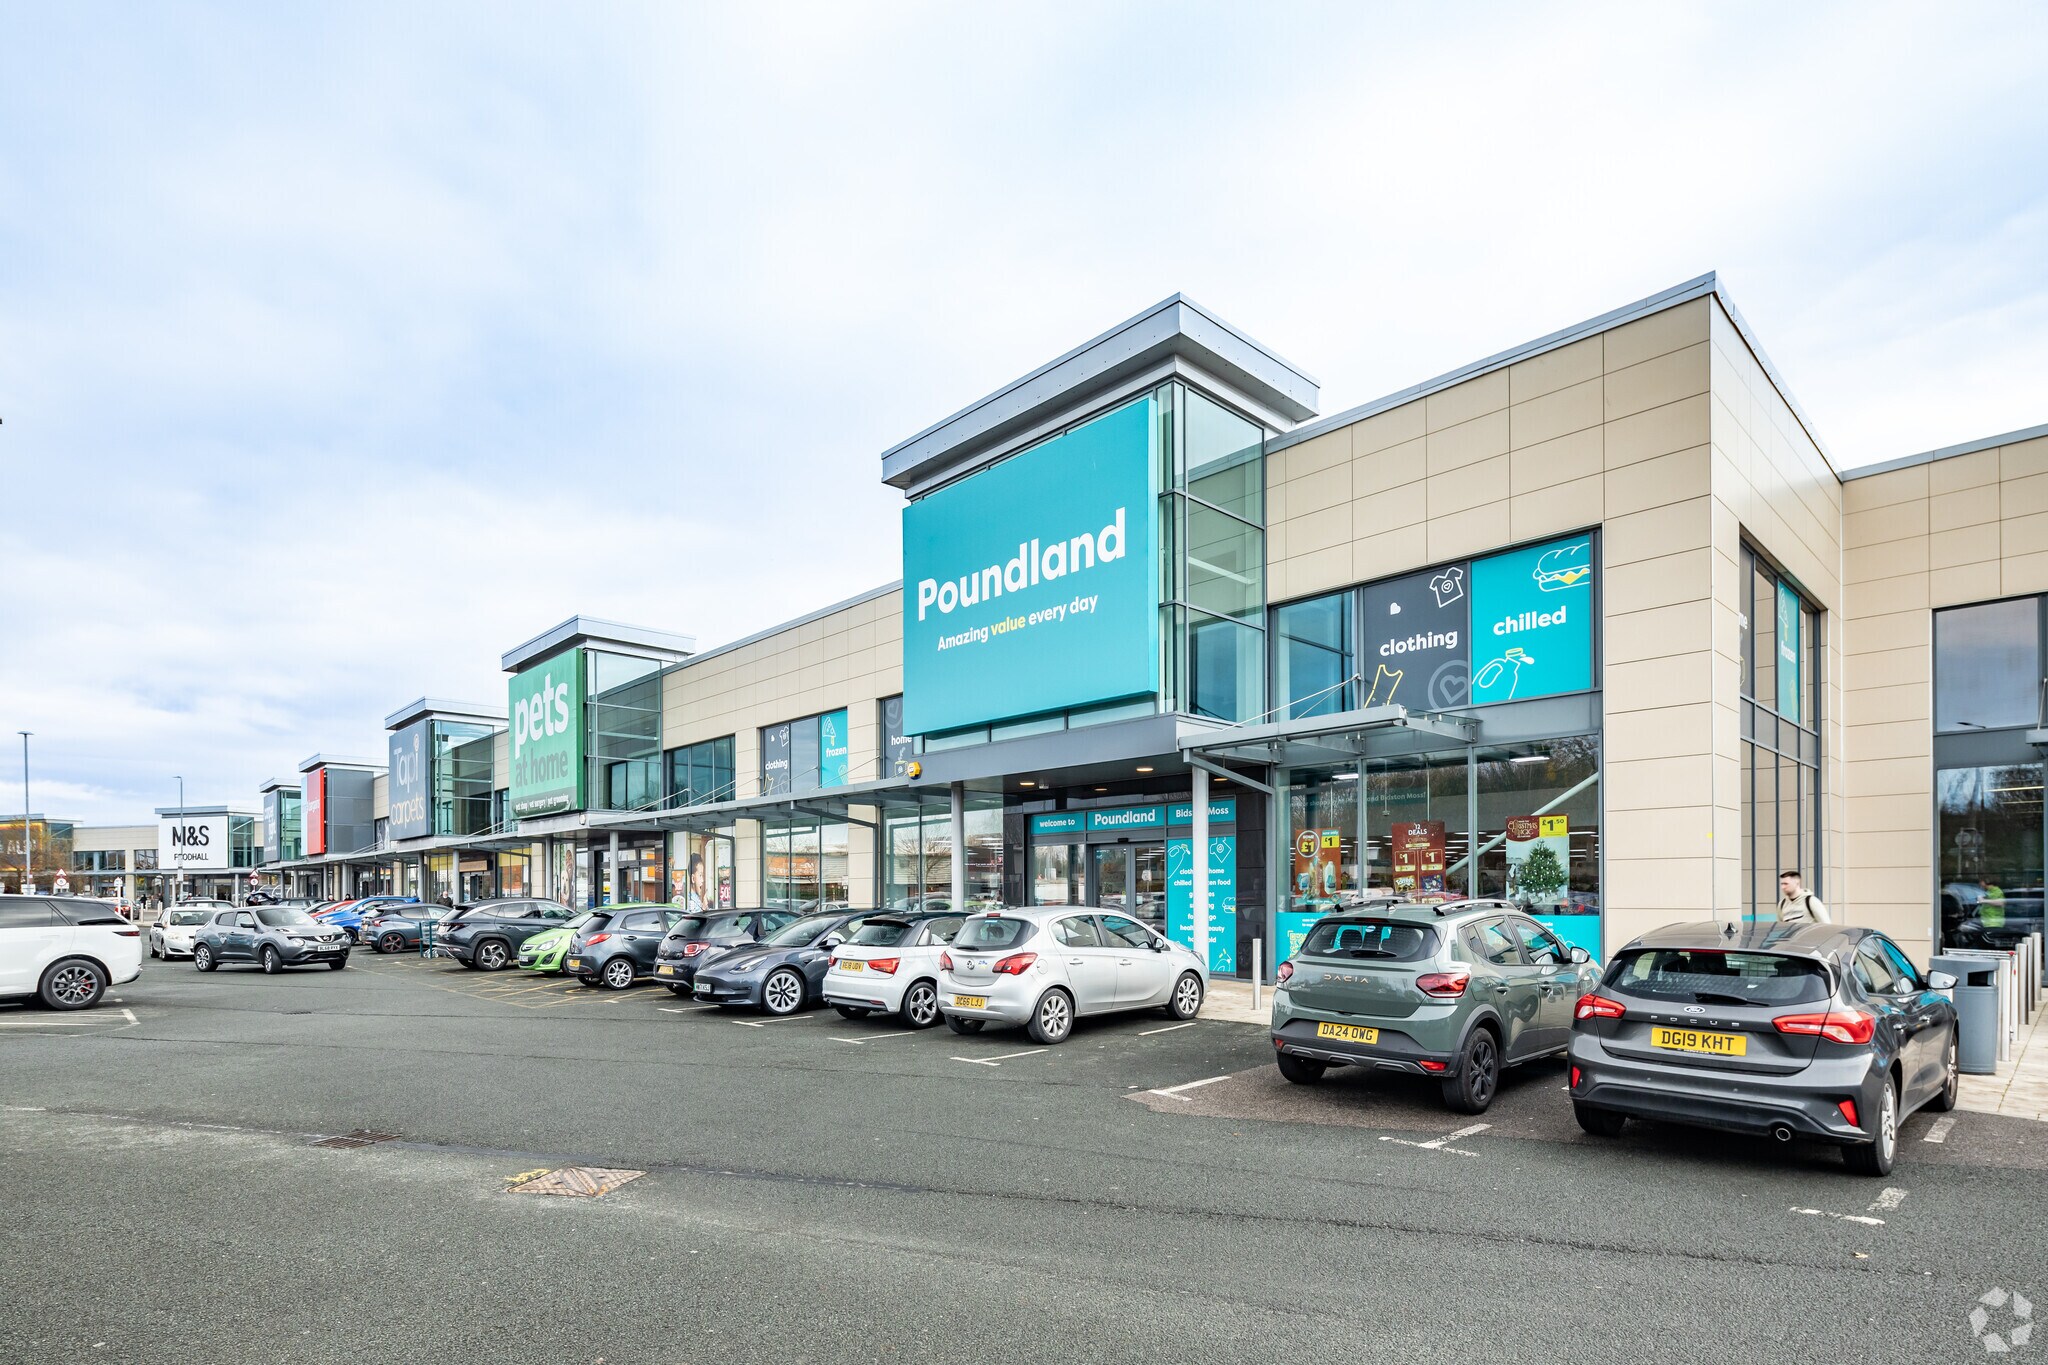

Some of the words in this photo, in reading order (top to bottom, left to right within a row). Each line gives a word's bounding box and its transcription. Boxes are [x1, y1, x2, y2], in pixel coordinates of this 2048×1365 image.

[917, 506, 1126, 622] Poundland
[937, 625, 989, 651] Amazing
[990, 613, 1026, 636] value
[1028, 603, 1067, 626] every
[1069, 593, 1099, 615] day
[1493, 605, 1567, 636] chilled
[1379, 630, 1458, 657] clothing
[1780, 640, 1796, 665] frozen
[514, 672, 569, 760] pets
[891, 735, 913, 746] home
[826, 746, 847, 758] frozen
[393, 733, 420, 793] Tapi
[515, 753, 528, 788] at
[530, 748, 569, 785] home
[765, 758, 788, 771] clothing
[391, 793, 425, 829] carpets
[1094, 809, 1155, 826] Poundland
[1208, 806, 1229, 816] Moss
[1039, 819, 1067, 828] welcome
[1067, 818, 1075, 826] to
[172, 825, 210, 846] M&S
[1408, 828, 1428, 836] DEALS
[1300, 841, 1315, 853] £1
[1324, 837, 1333, 847] £1
[173, 853, 209, 861] FODHALL
[1217, 878, 1231, 886] food
[1323, 973, 1369, 984] DACIA
[1650, 1015, 1740, 1027] FOCUS
[1322, 1024, 1349, 1038] DA24
[1351, 1027, 1373, 1041] OWG
[1661, 1030, 1696, 1047] DG19
[1701, 1034, 1735, 1051] KHT
